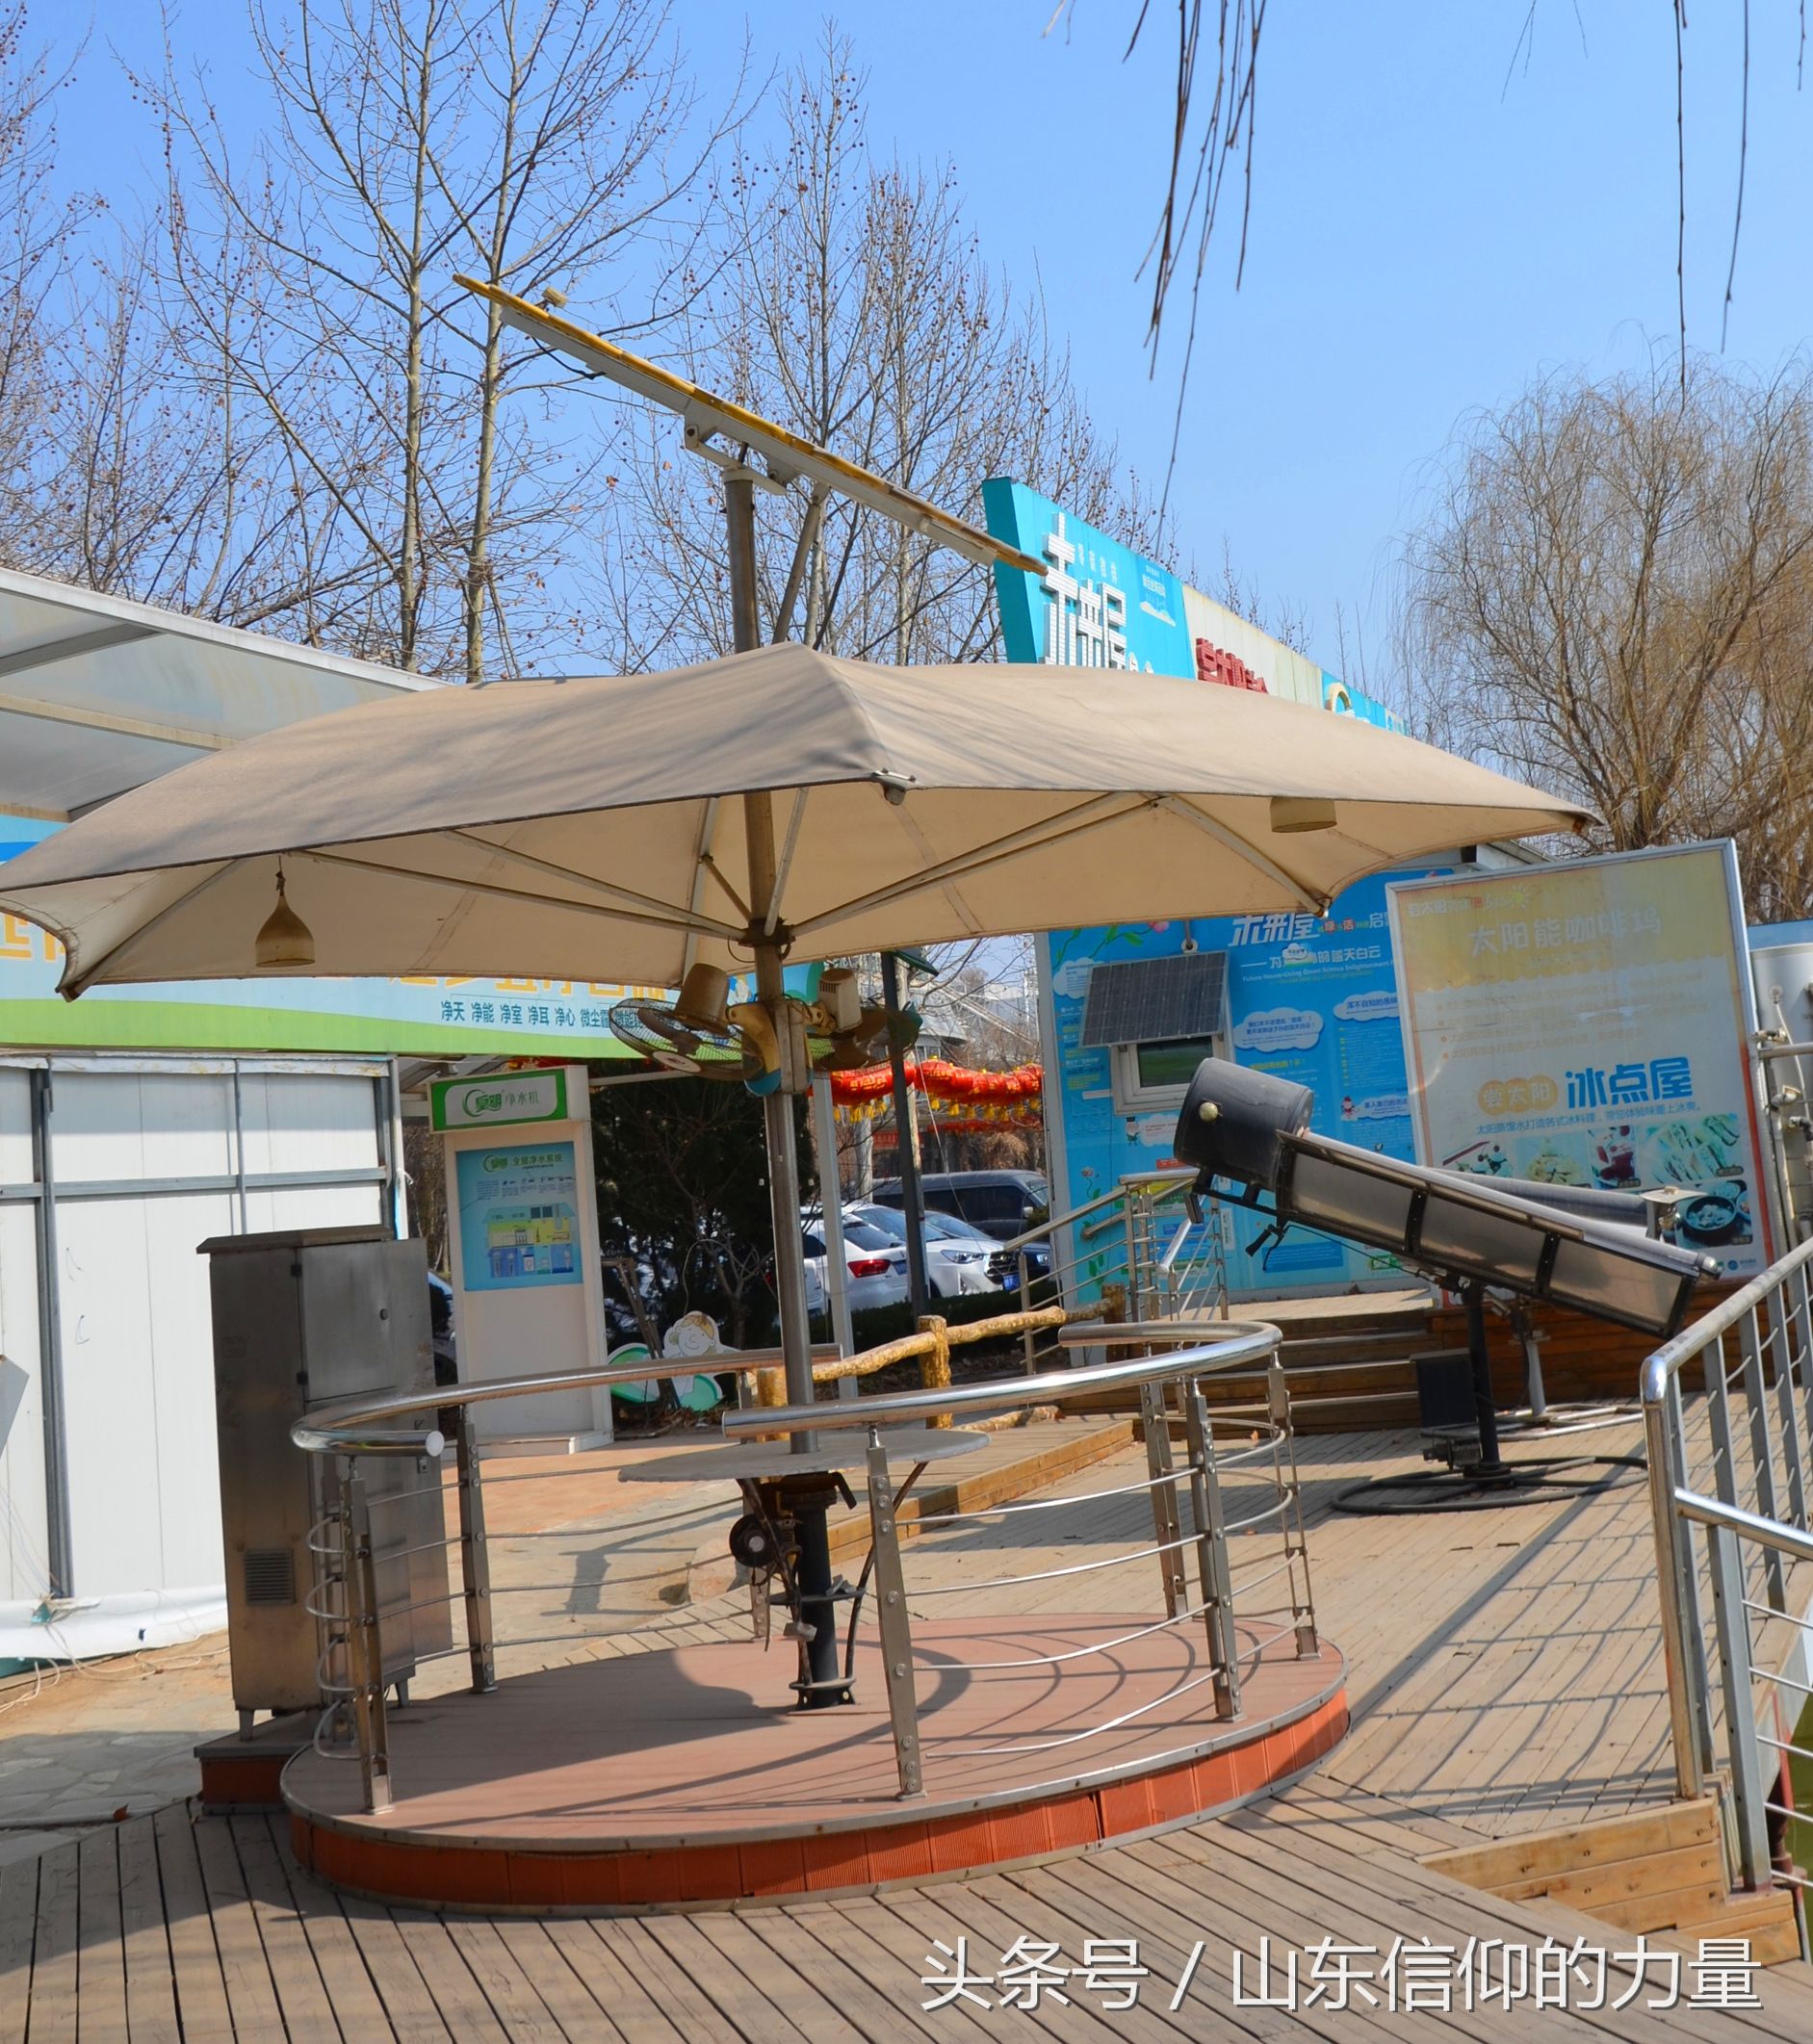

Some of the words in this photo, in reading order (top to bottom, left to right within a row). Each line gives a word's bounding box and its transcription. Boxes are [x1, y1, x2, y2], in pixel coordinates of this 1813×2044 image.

[1228, 913, 1321, 947] 未来屋
[440, 1001, 466, 1022] 净天
[471, 1002, 495, 1024] 净能
[500, 1003, 523, 1025] 净室
[528, 1005, 550, 1026] 净耳
[555, 1007, 576, 1027] 净心
[1566, 1056, 1693, 1109] 冰点屋
[505, 1090, 540, 1107] 净水机
